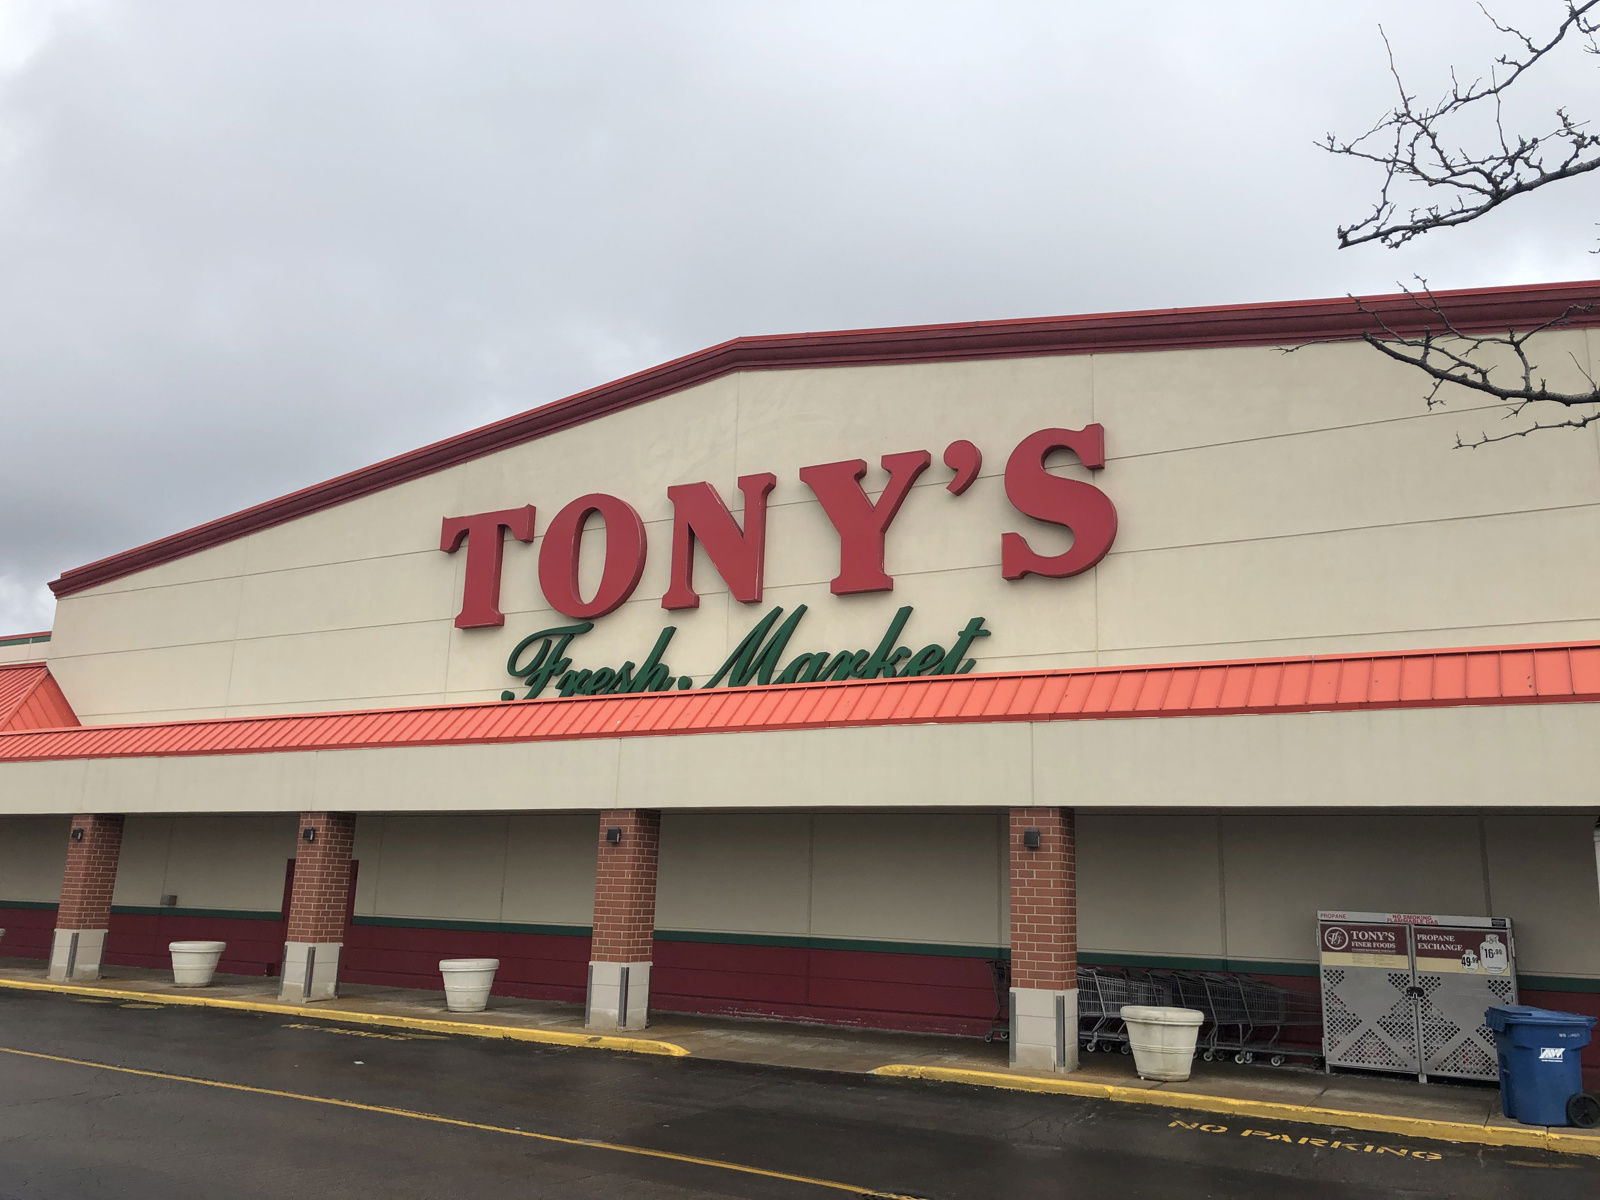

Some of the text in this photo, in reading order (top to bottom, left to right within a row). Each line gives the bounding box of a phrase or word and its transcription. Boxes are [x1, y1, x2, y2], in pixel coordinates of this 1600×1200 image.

[439, 422, 1118, 630] TONY'S
[678, 603, 991, 691] Market
[1319, 912, 1347, 920] PROPANE
[1350, 930, 1396, 941] TONY'S
[1416, 933, 1456, 942] PROPANE
[1351, 941, 1373, 949] FINER
[1417, 942, 1464, 952] EXCHANGE
[1167, 1119, 1444, 1161] NO PARKING
